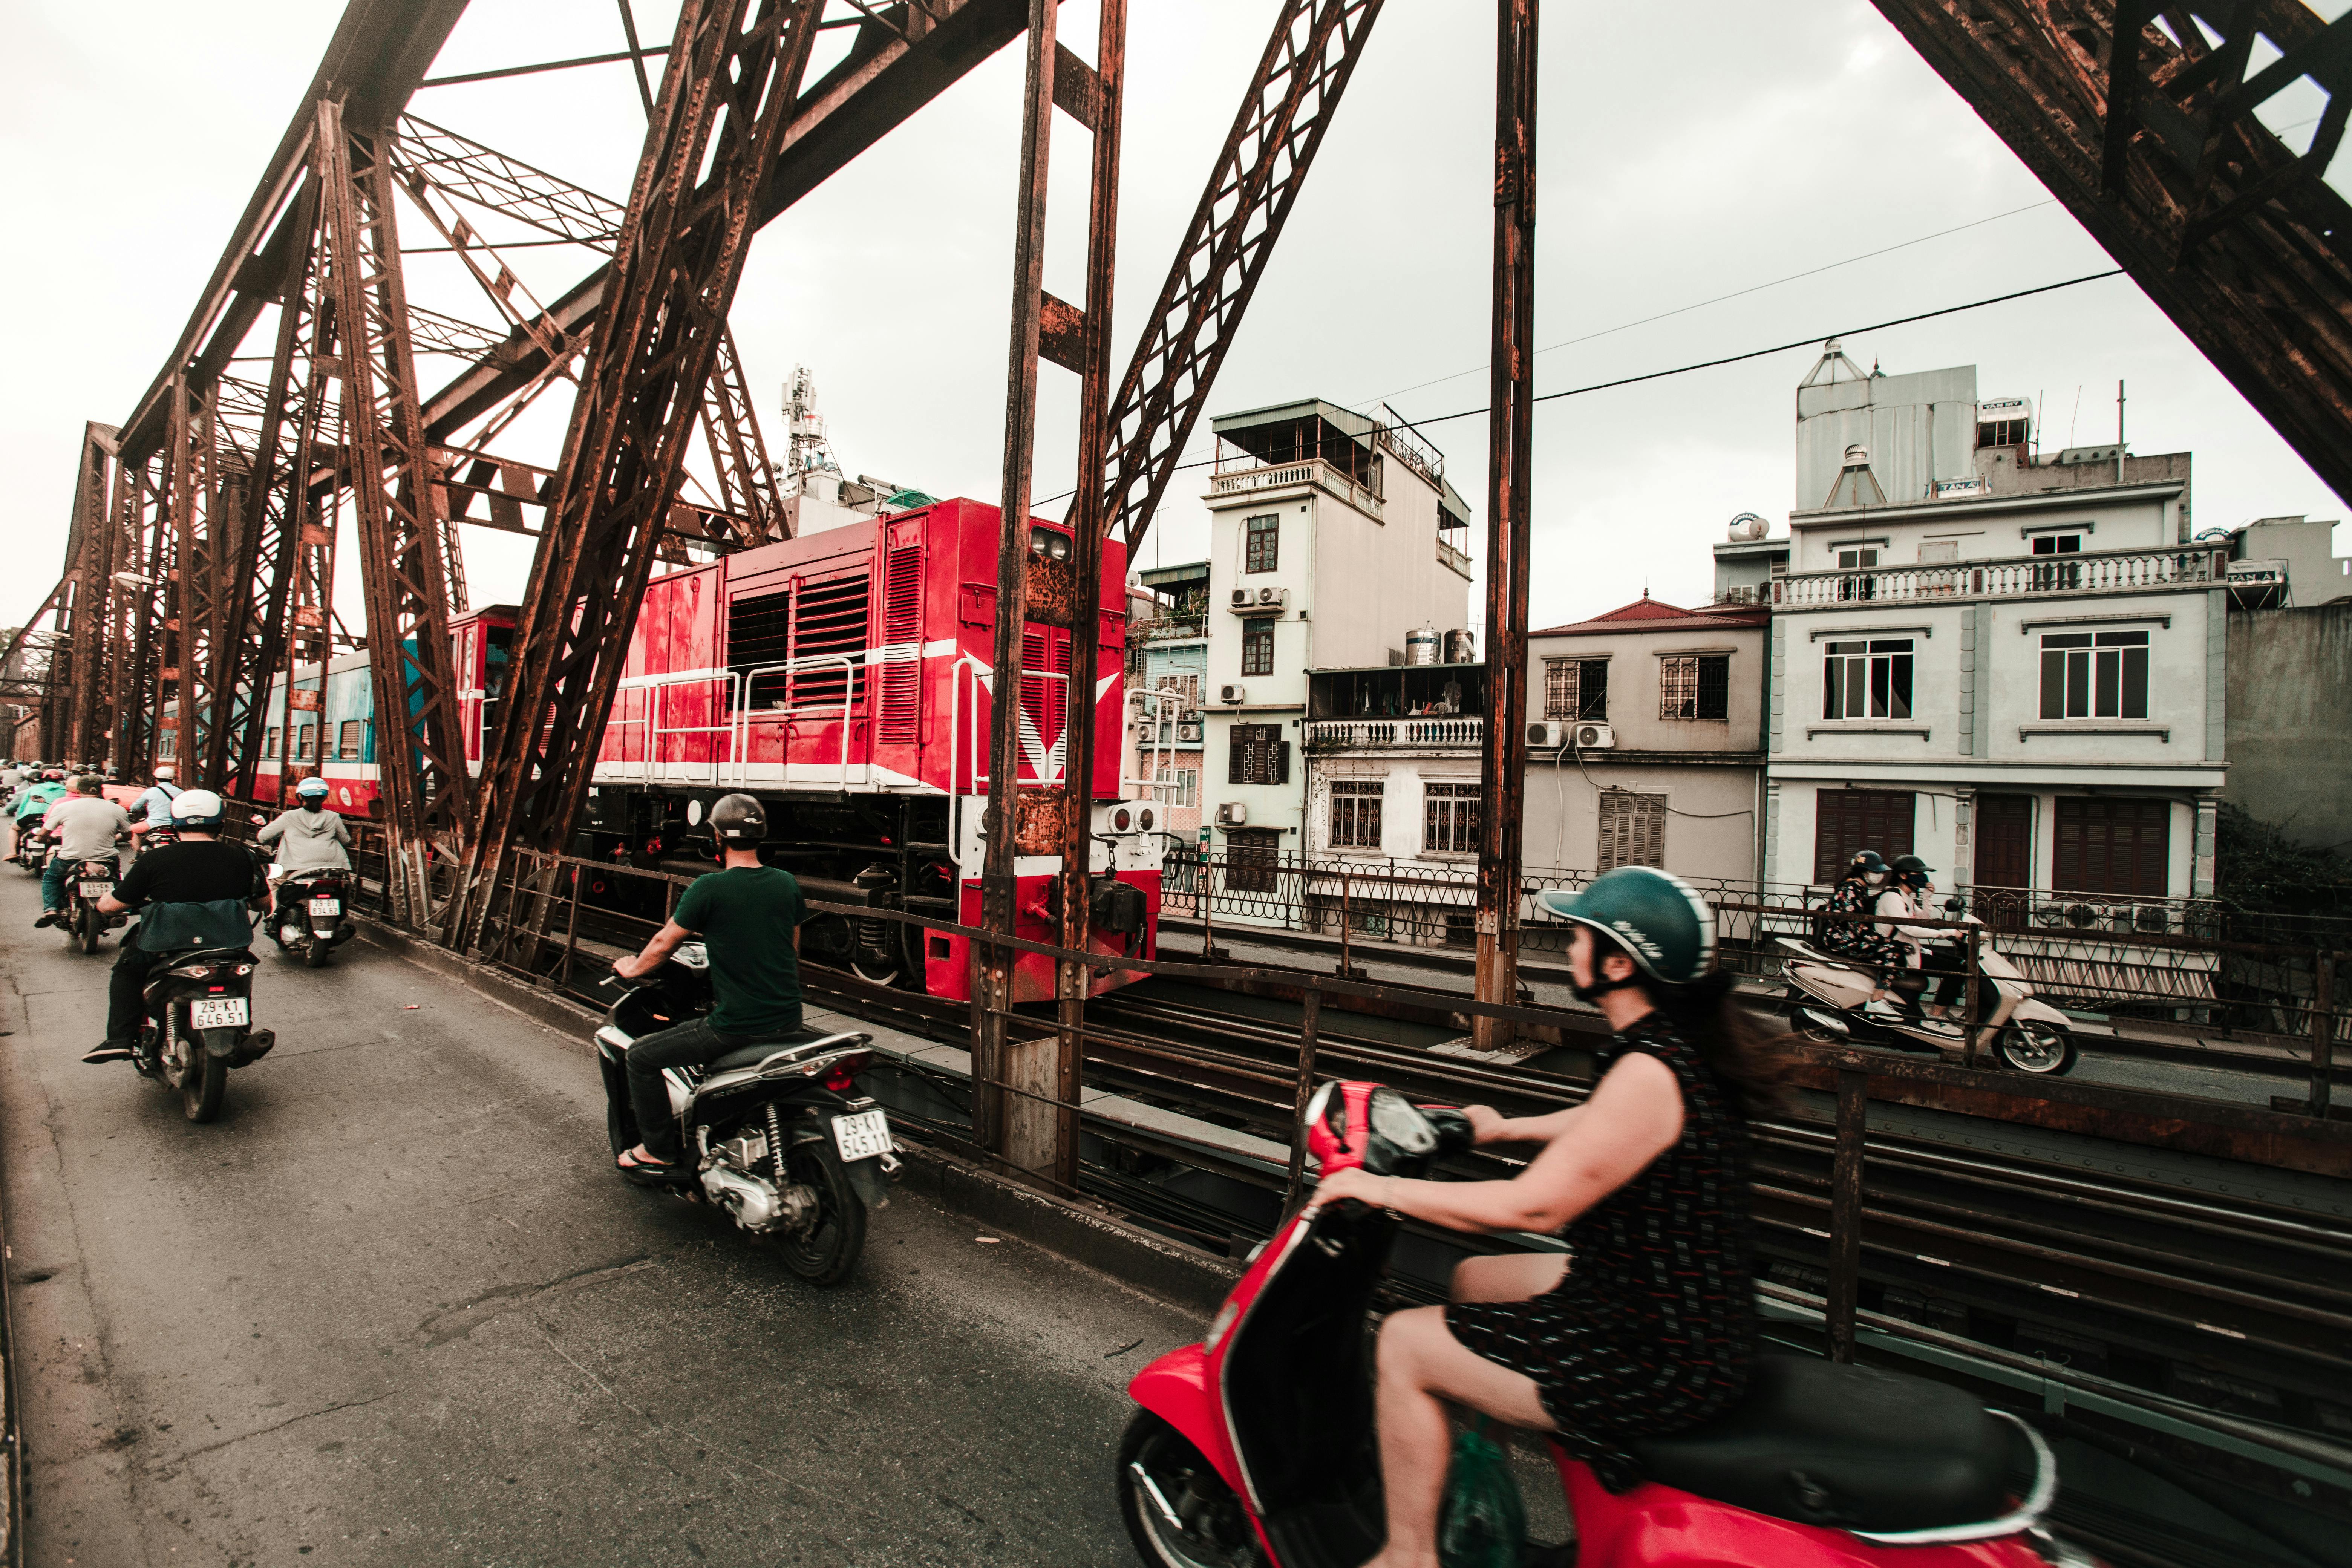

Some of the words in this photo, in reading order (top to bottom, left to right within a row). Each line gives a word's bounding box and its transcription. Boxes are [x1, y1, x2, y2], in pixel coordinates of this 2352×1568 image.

[202, 1000, 238, 1013] 29-K1
[198, 1012, 243, 1026] 646.51
[842, 1113, 880, 1136] 29-K1
[842, 1132, 889, 1158] 545.11
